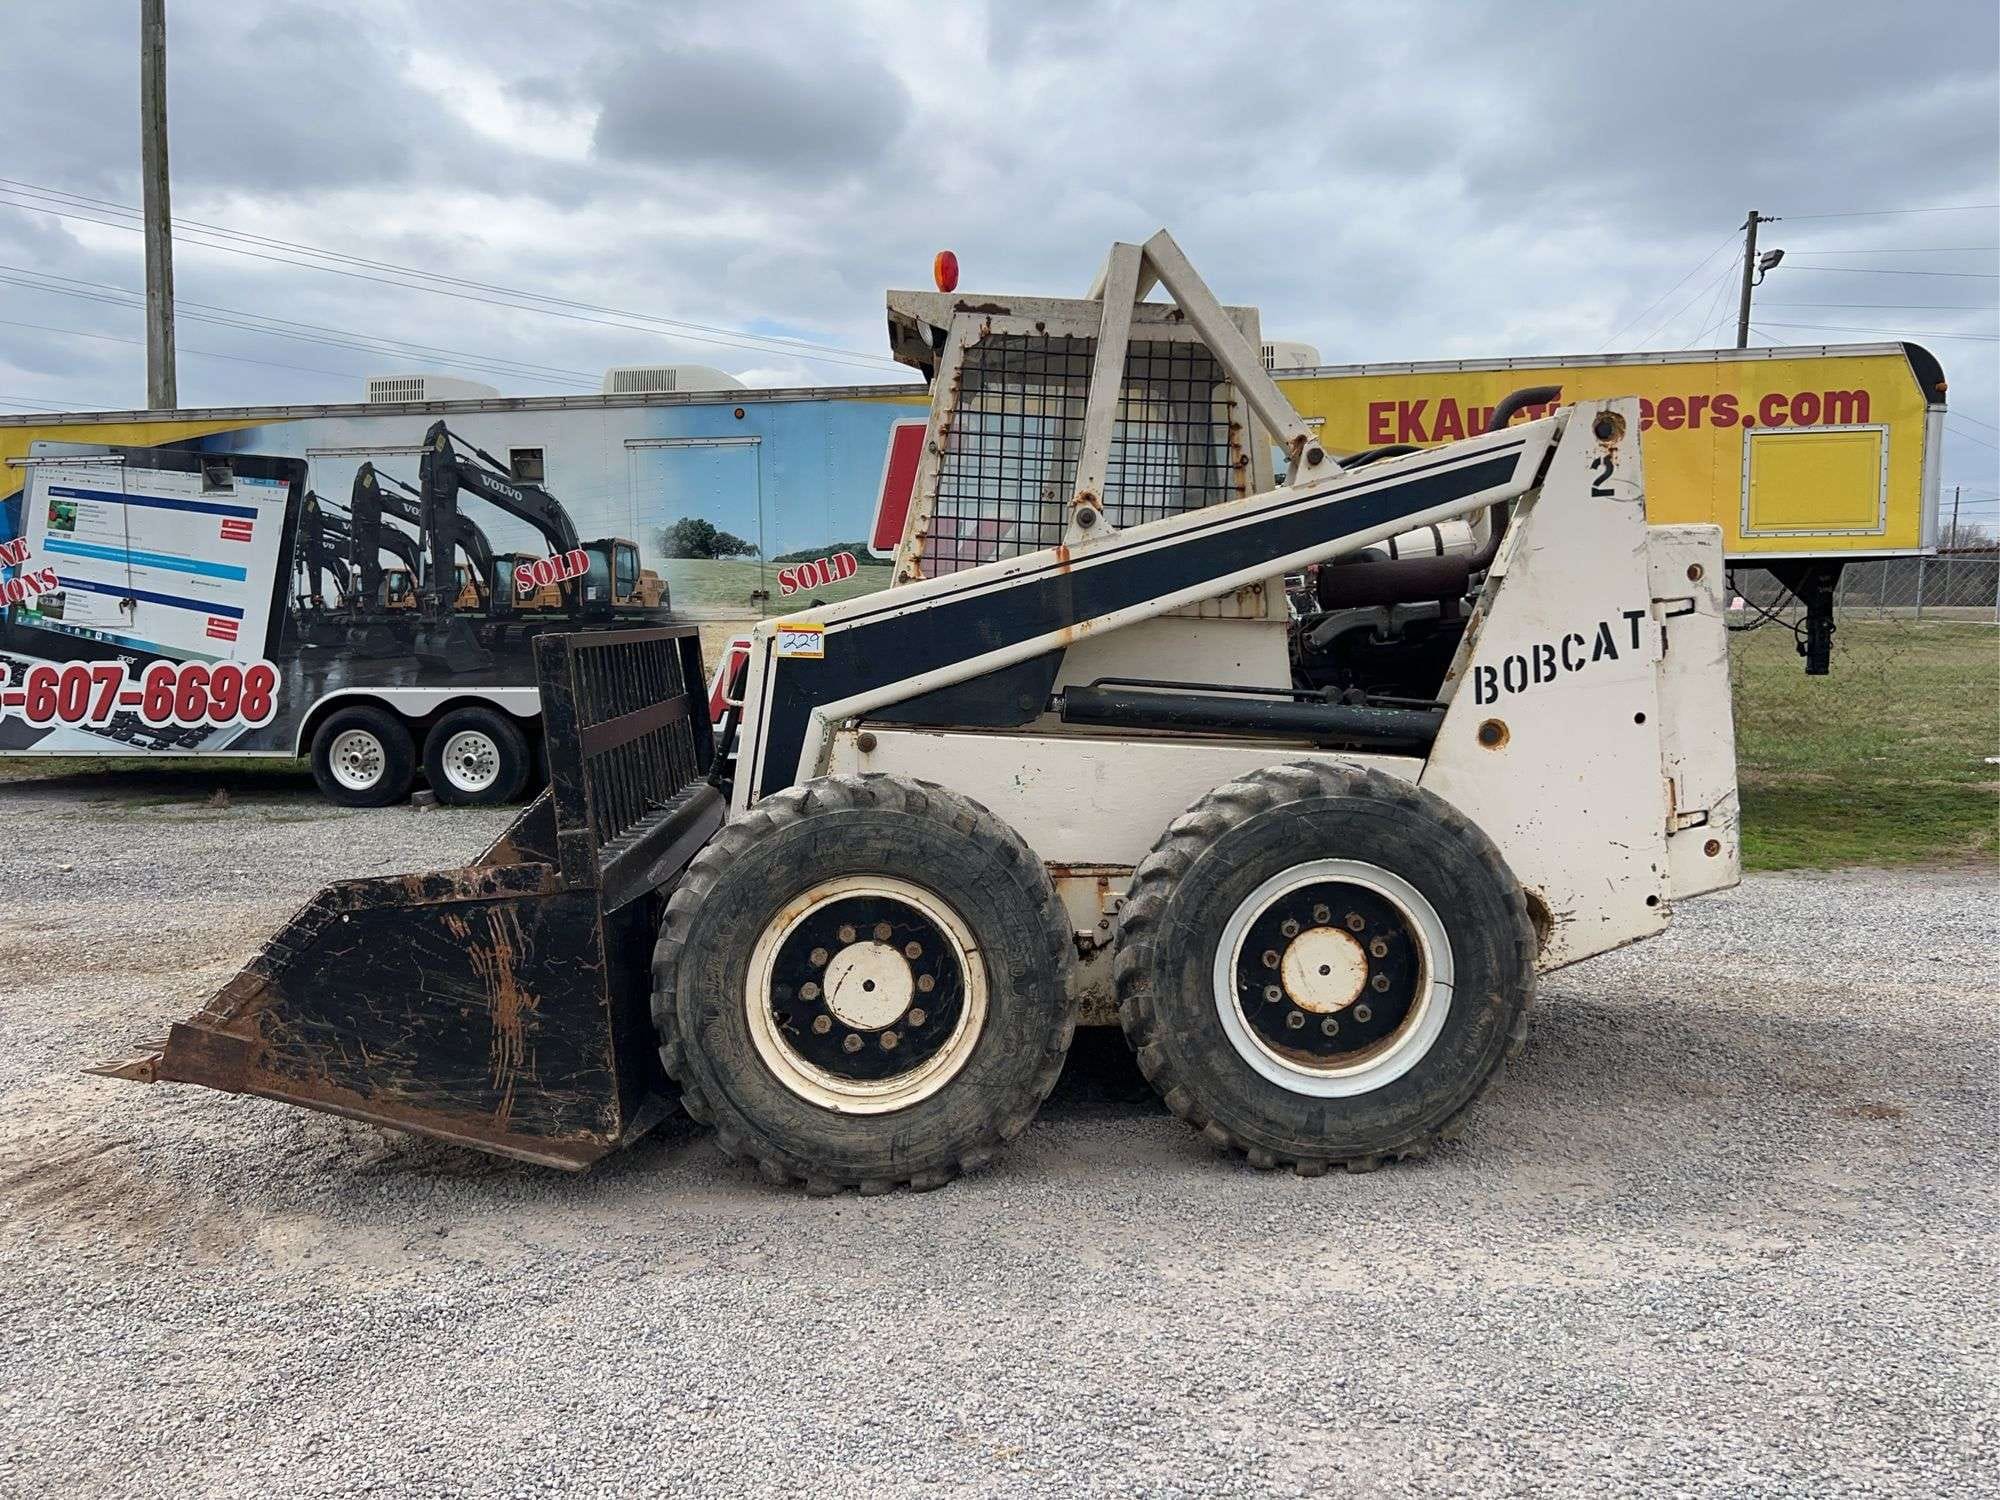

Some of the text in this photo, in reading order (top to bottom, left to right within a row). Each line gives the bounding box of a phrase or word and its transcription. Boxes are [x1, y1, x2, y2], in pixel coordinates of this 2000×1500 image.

[480, 473, 522, 500] VOLVO
[1591, 454, 1615, 497] 2
[514, 549, 590, 592] SOLD
[778, 552, 857, 597] SOLD
[783, 632, 820, 650] 229
[1474, 610, 1645, 704] BOBCAT
[0, 665, 275, 722] -607-6698
